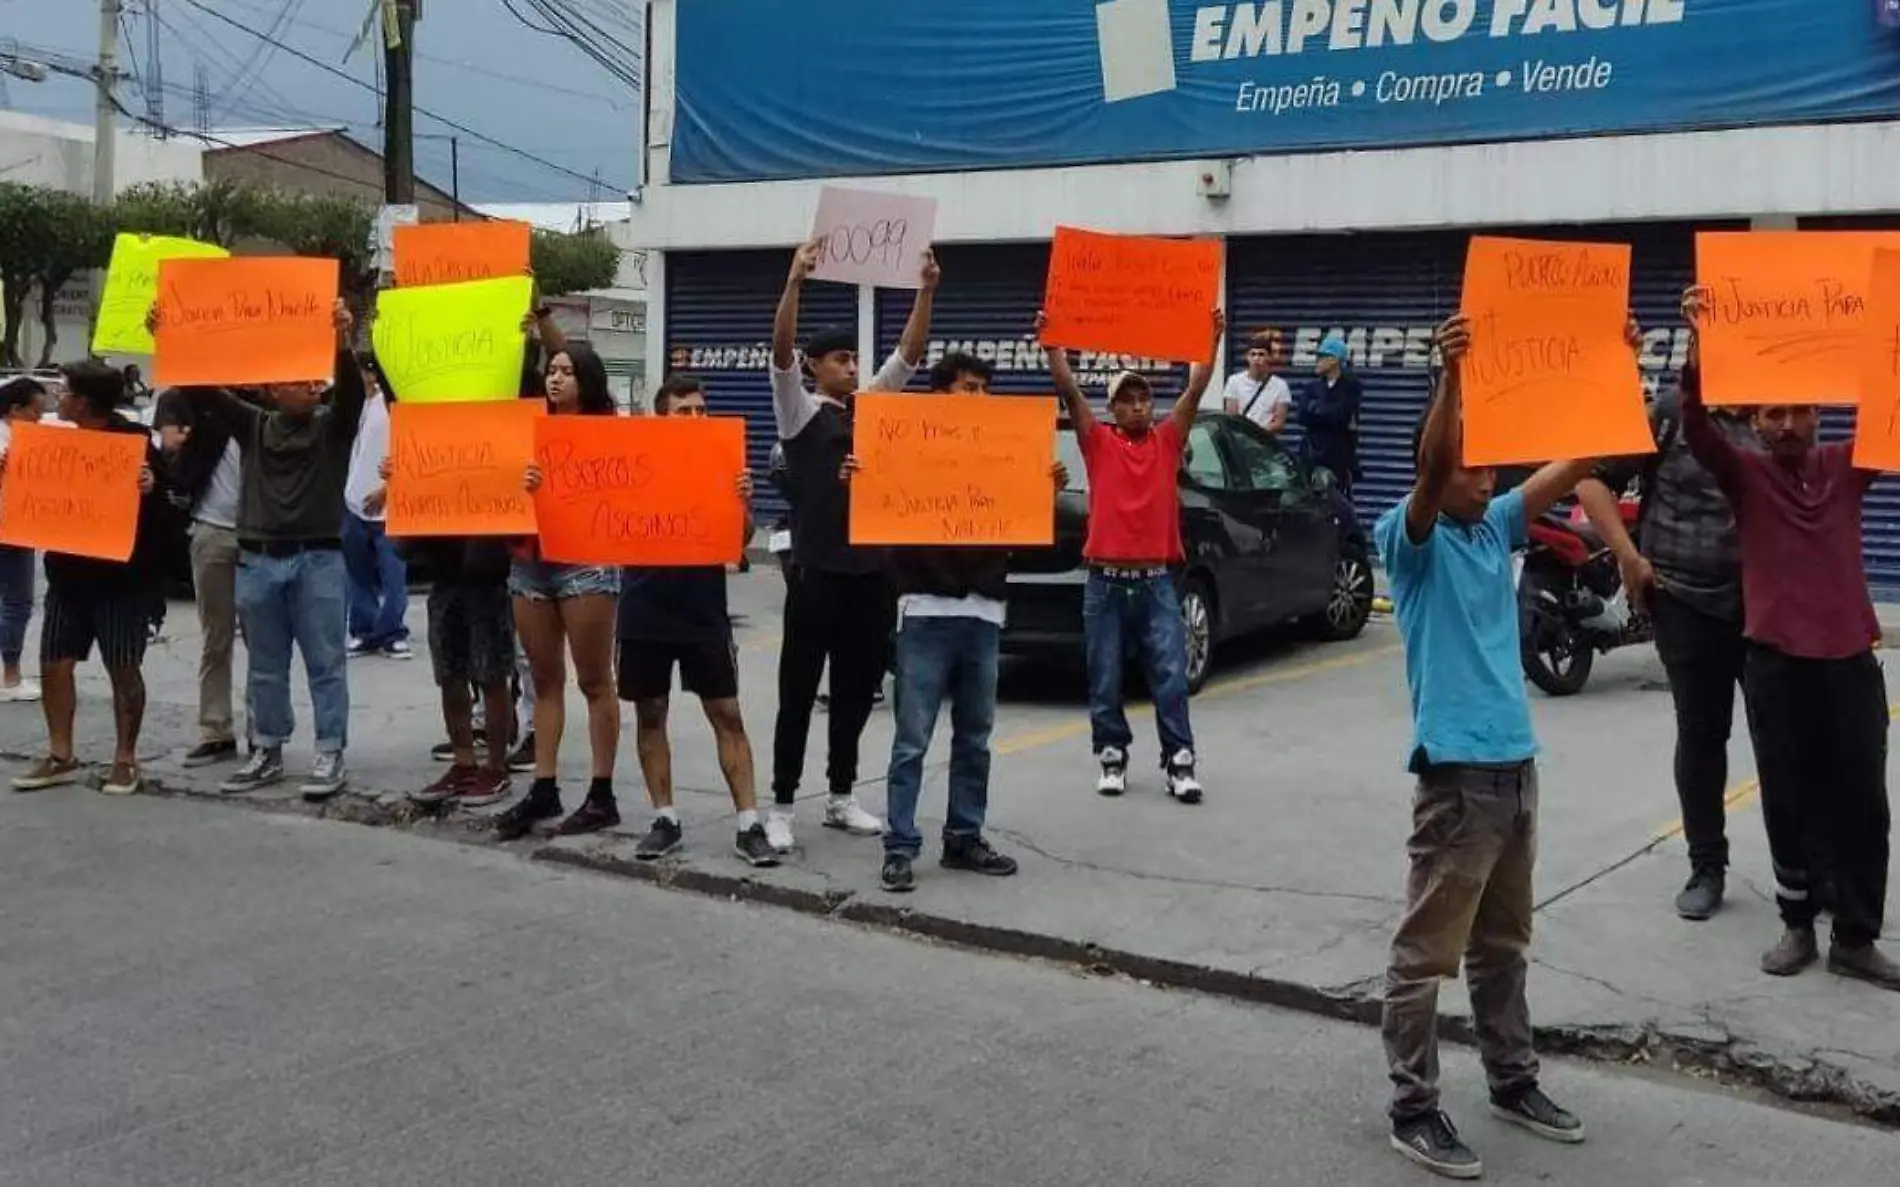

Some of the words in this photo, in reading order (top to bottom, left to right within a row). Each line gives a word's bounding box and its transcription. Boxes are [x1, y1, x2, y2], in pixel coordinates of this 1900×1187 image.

[1236, 75, 1340, 115] Empeña
[1376, 70, 1484, 104] Compra
[1521, 56, 1613, 94] Vende
[691, 341, 771, 369] EMPEÑ
